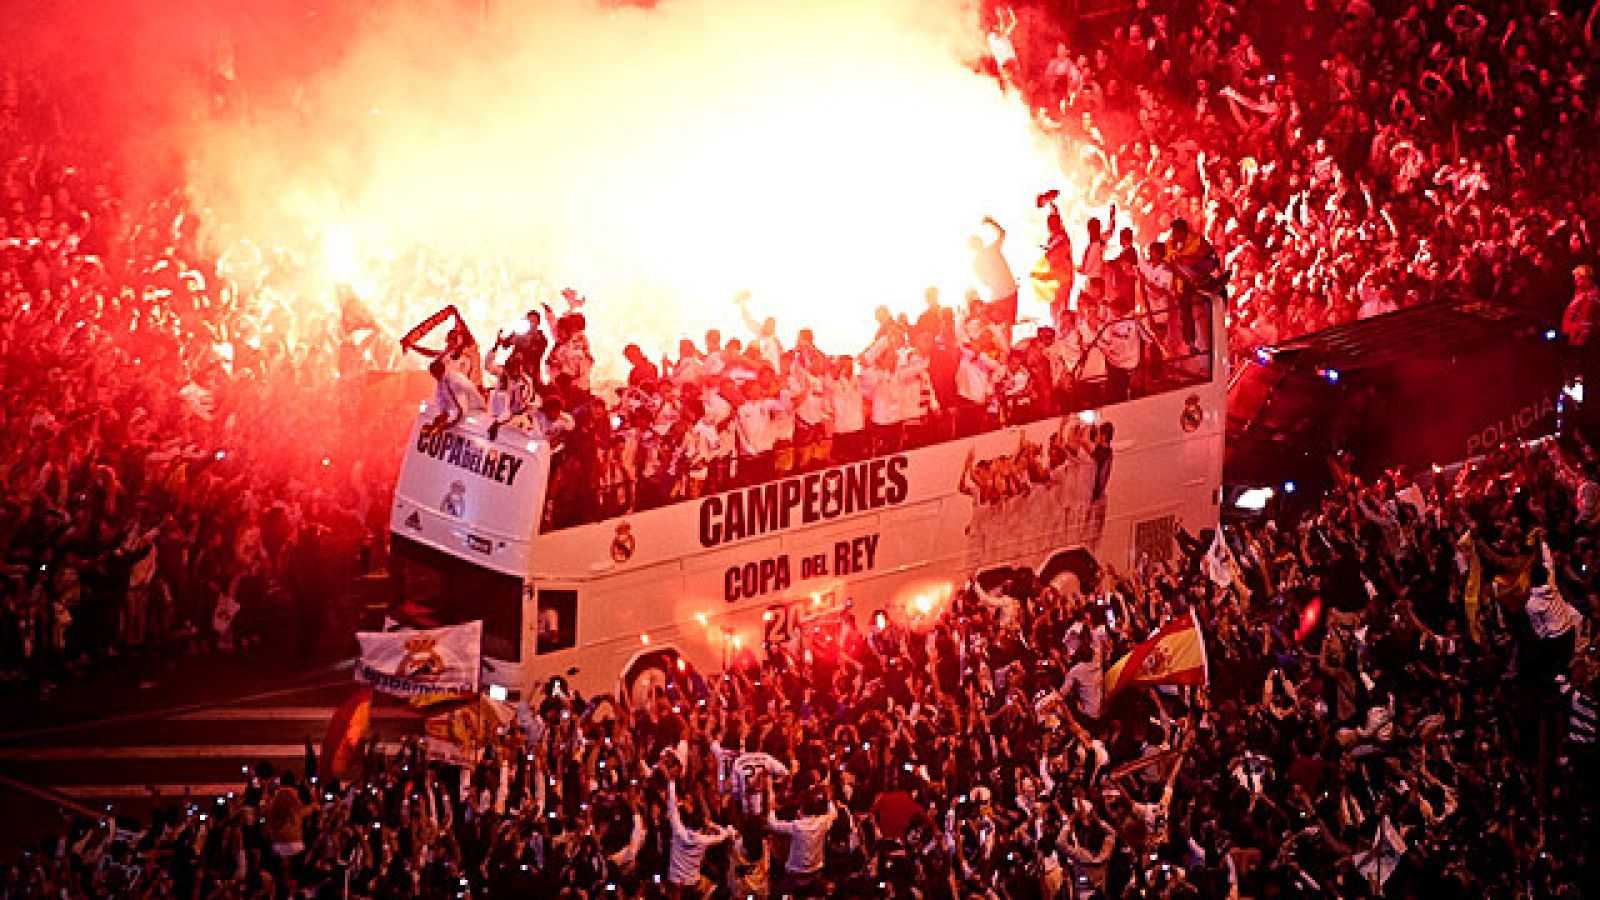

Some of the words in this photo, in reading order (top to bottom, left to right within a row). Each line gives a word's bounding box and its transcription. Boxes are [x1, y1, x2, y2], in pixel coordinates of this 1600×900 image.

[1467, 396, 1554, 456] POLICIA
[699, 456, 909, 548] CAMPEONES
[724, 555, 790, 603] COPA
[801, 554, 828, 580] DEL
[834, 534, 880, 577] REY
